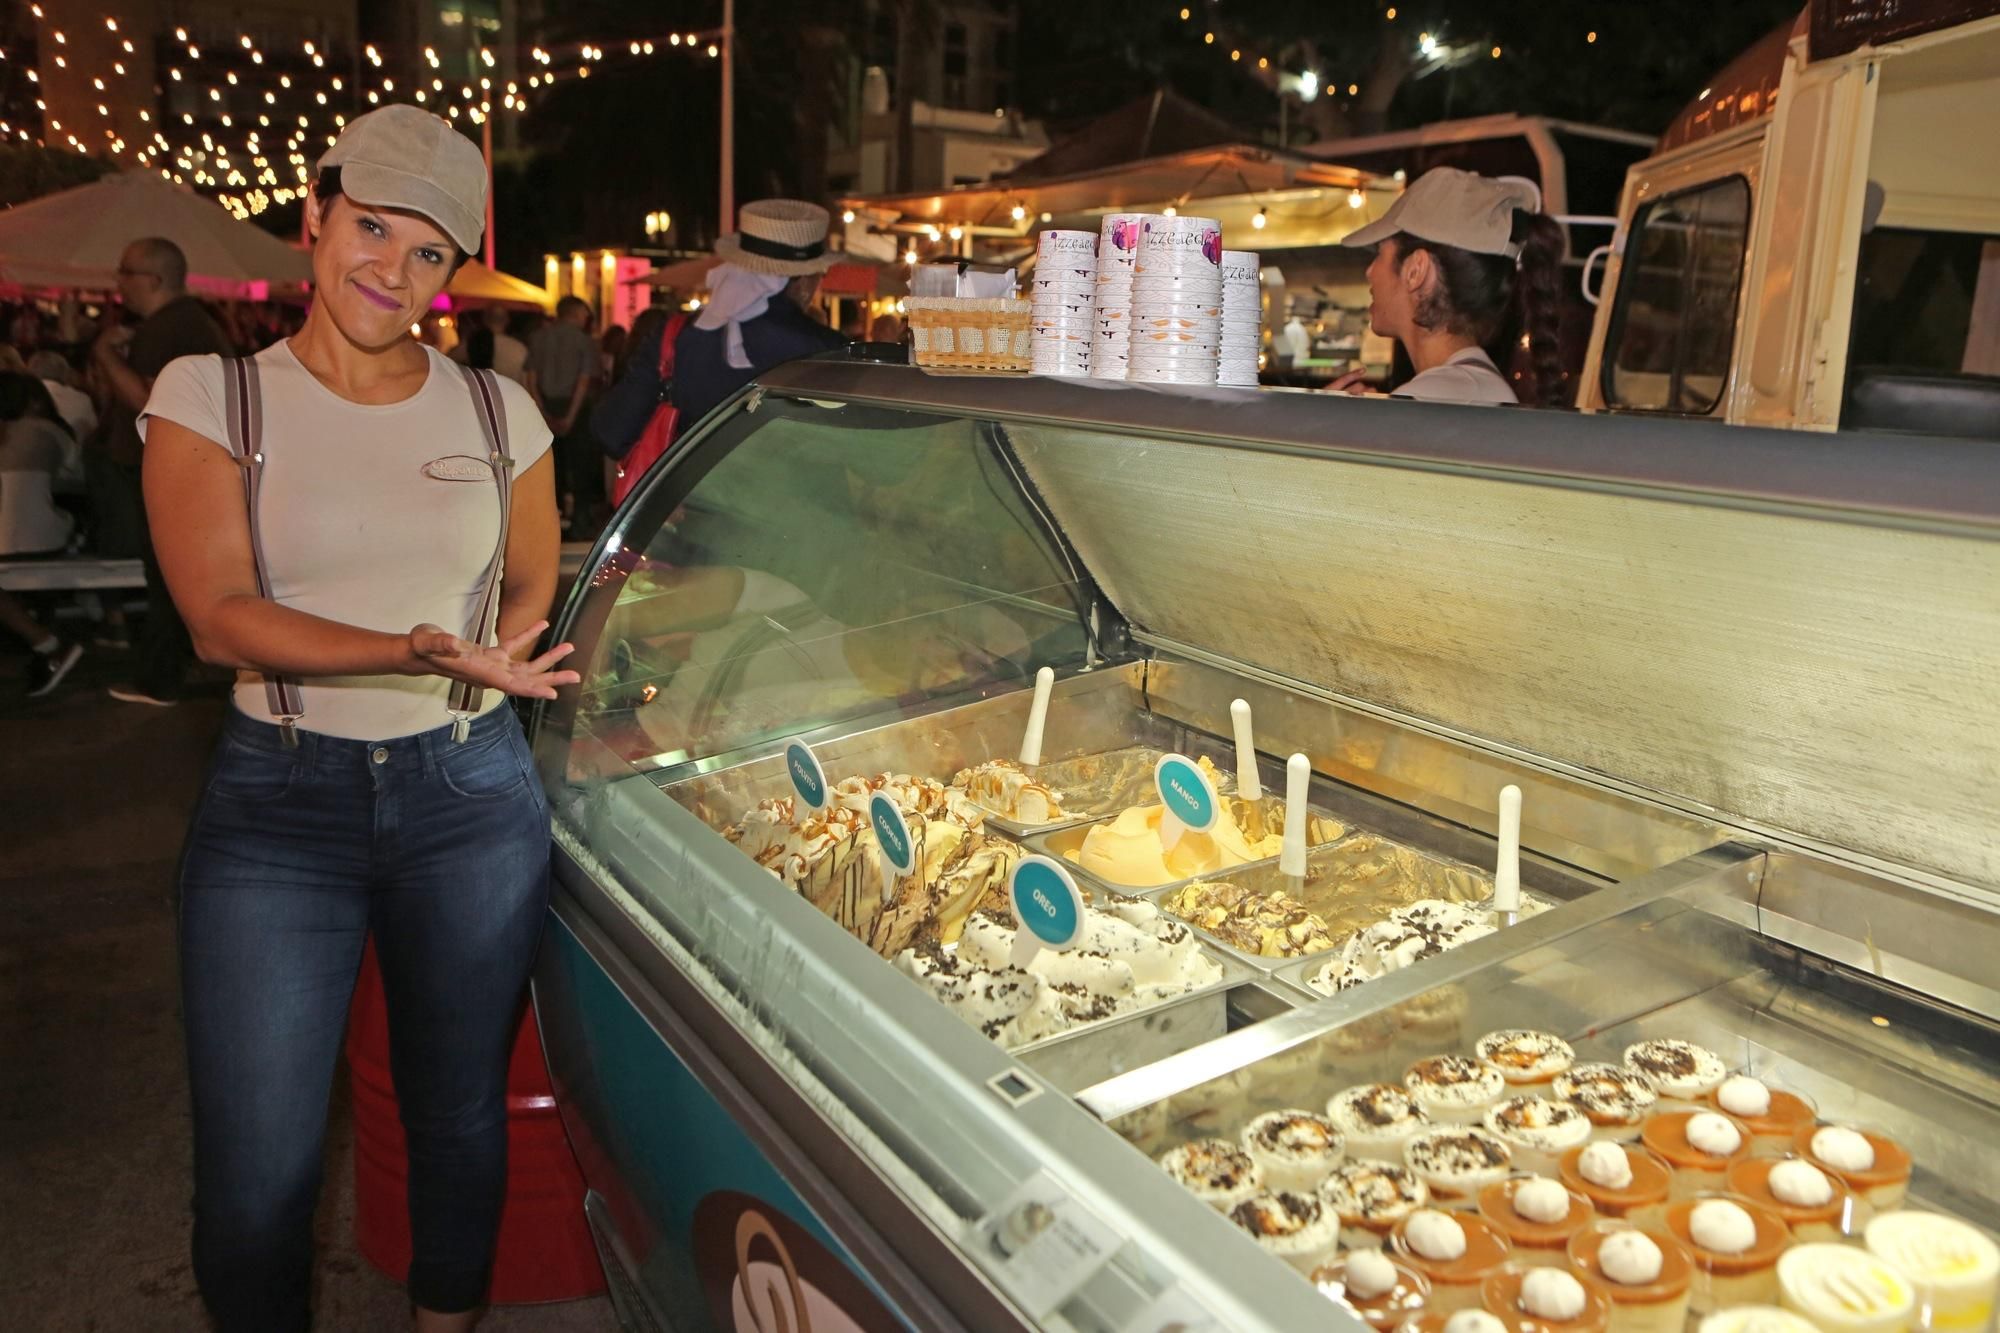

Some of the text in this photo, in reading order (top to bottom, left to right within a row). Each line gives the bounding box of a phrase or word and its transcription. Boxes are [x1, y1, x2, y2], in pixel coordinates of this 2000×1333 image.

[1170, 778, 1199, 810] MANGO
[879, 815, 902, 847] COOKIES
[1032, 888, 1057, 918] OREO
